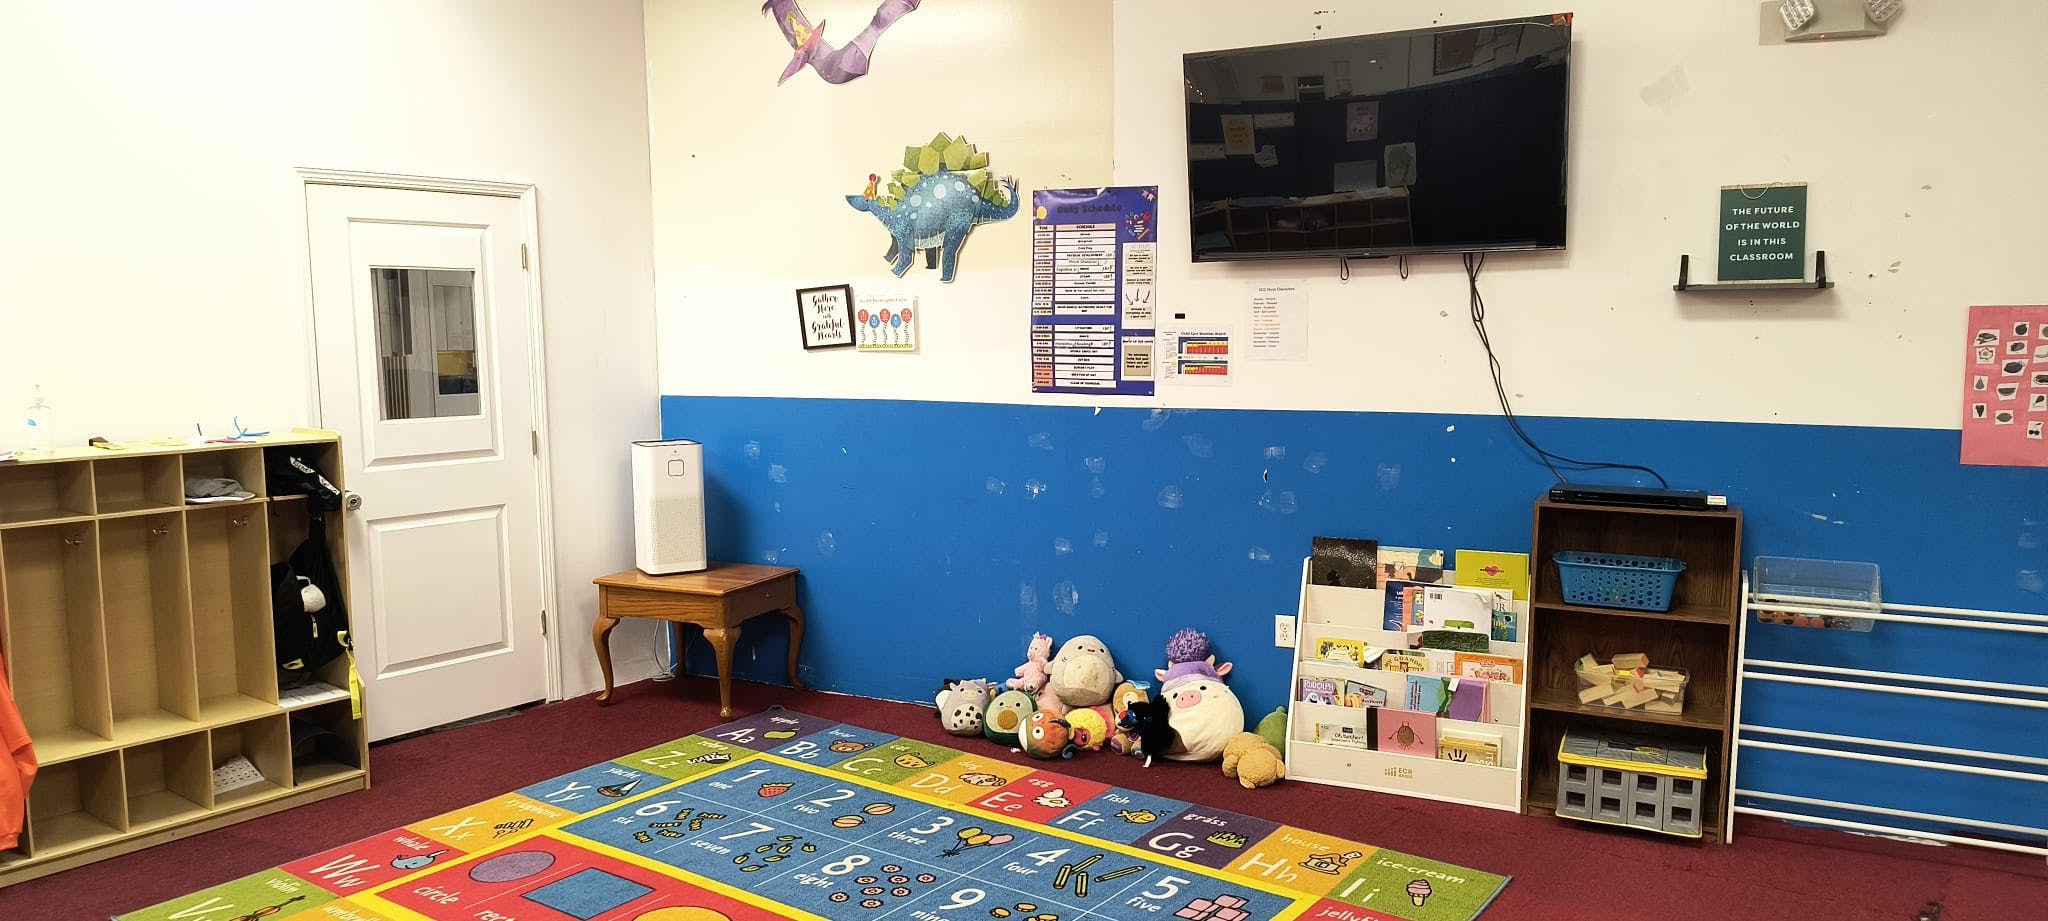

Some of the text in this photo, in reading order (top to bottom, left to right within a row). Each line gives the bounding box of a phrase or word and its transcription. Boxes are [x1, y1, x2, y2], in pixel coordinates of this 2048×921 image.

[1057, 203, 1122, 214] Daily Schedule
[1754, 206, 1794, 214] FUTURE
[1725, 221, 1800, 231] OF THE WORLD
[1763, 237, 1786, 245] THIS
[1729, 252, 1793, 261] CLASSROOM
[812, 292, 838, 307] Gather
[812, 318, 843, 334] Grateful
[1304, 680, 1333, 691] RUDOLPH
[717, 728, 756, 743] Aa
[830, 729, 856, 738] bear
[780, 741, 819, 759] Bb
[641, 750, 686, 769] Zz
[843, 758, 884, 775] Cc
[958, 760, 982, 771] dog
[603, 766, 641, 781] yacht
[732, 769, 771, 783] 1
[709, 781, 733, 790] one
[911, 773, 956, 795] Dd
[1028, 777, 1055, 789] egg
[545, 781, 591, 804] Yy
[809, 789, 857, 807] 2
[1102, 793, 1130, 805] fish
[635, 800, 682, 816] 6
[794, 804, 820, 815] two
[980, 791, 1024, 812] Ee
[612, 815, 634, 825] six
[910, 816, 954, 835] 3
[1056, 810, 1105, 830] Ff
[1182, 812, 1228, 827] grass
[430, 816, 487, 841] Xx
[719, 822, 778, 841] 7
[394, 834, 430, 850] whale
[887, 829, 927, 846] three
[1148, 832, 1206, 859] Gg
[1281, 834, 1332, 851] house
[690, 839, 731, 855] seven
[821, 855, 871, 875] 8
[1025, 848, 1072, 867] 4
[309, 854, 380, 889] Ww
[1002, 862, 1038, 877] four
[1377, 857, 1466, 884] ice-cream
[793, 872, 835, 890] eight
[1142, 875, 1191, 899] 5
[413, 884, 460, 905] circle
[939, 888, 986, 910] 9
[1124, 896, 1162, 913] five
